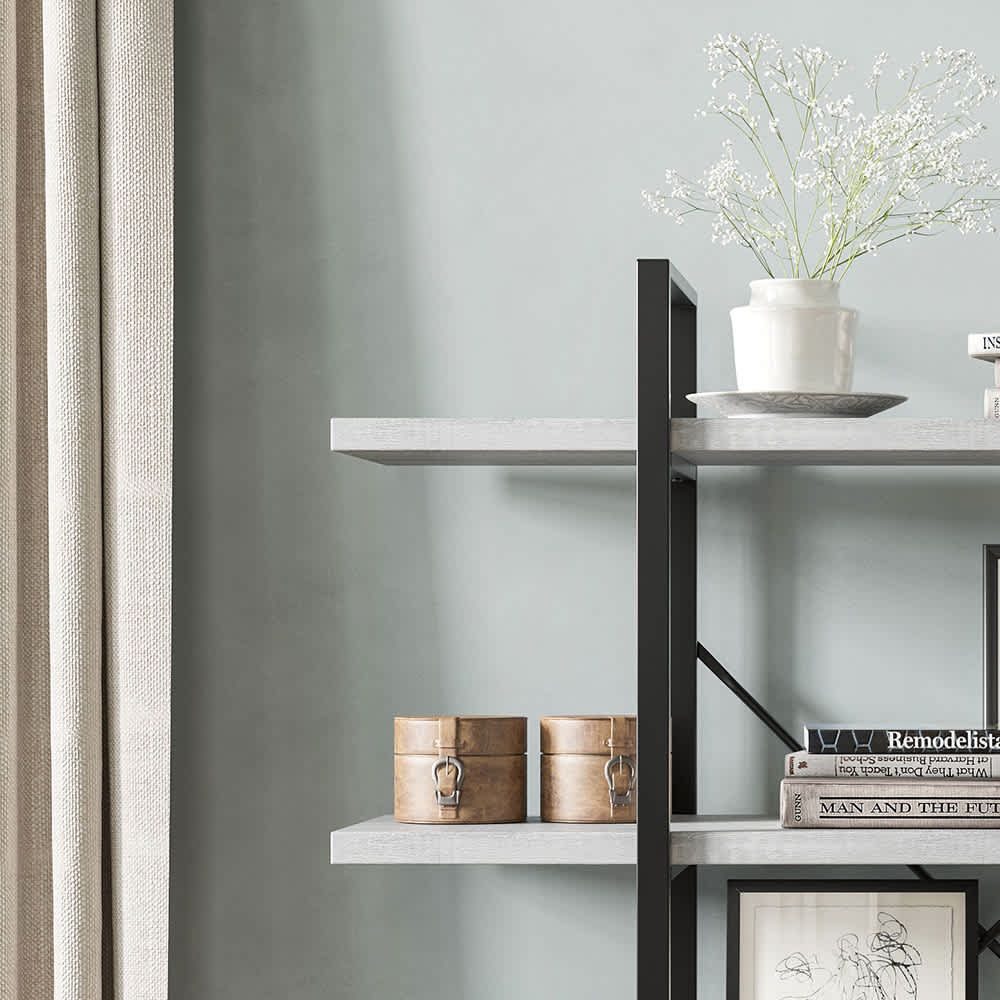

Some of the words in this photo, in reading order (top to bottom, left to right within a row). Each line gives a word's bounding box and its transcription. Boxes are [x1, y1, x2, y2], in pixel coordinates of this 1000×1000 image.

[840, 756, 875, 765] School
[878, 756, 926, 765] Business
[929, 757, 975, 765] Harvard
[839, 767, 859, 777] You
[861, 767, 893, 777] Teach
[895, 767, 923, 777] Don't
[926, 766, 954, 778] They
[956, 767, 987, 778] What
[794, 793, 802, 822] GUNN
[819, 801, 864, 814] MAN
[870, 801, 912, 814] AND
[917, 801, 958, 814] THE
